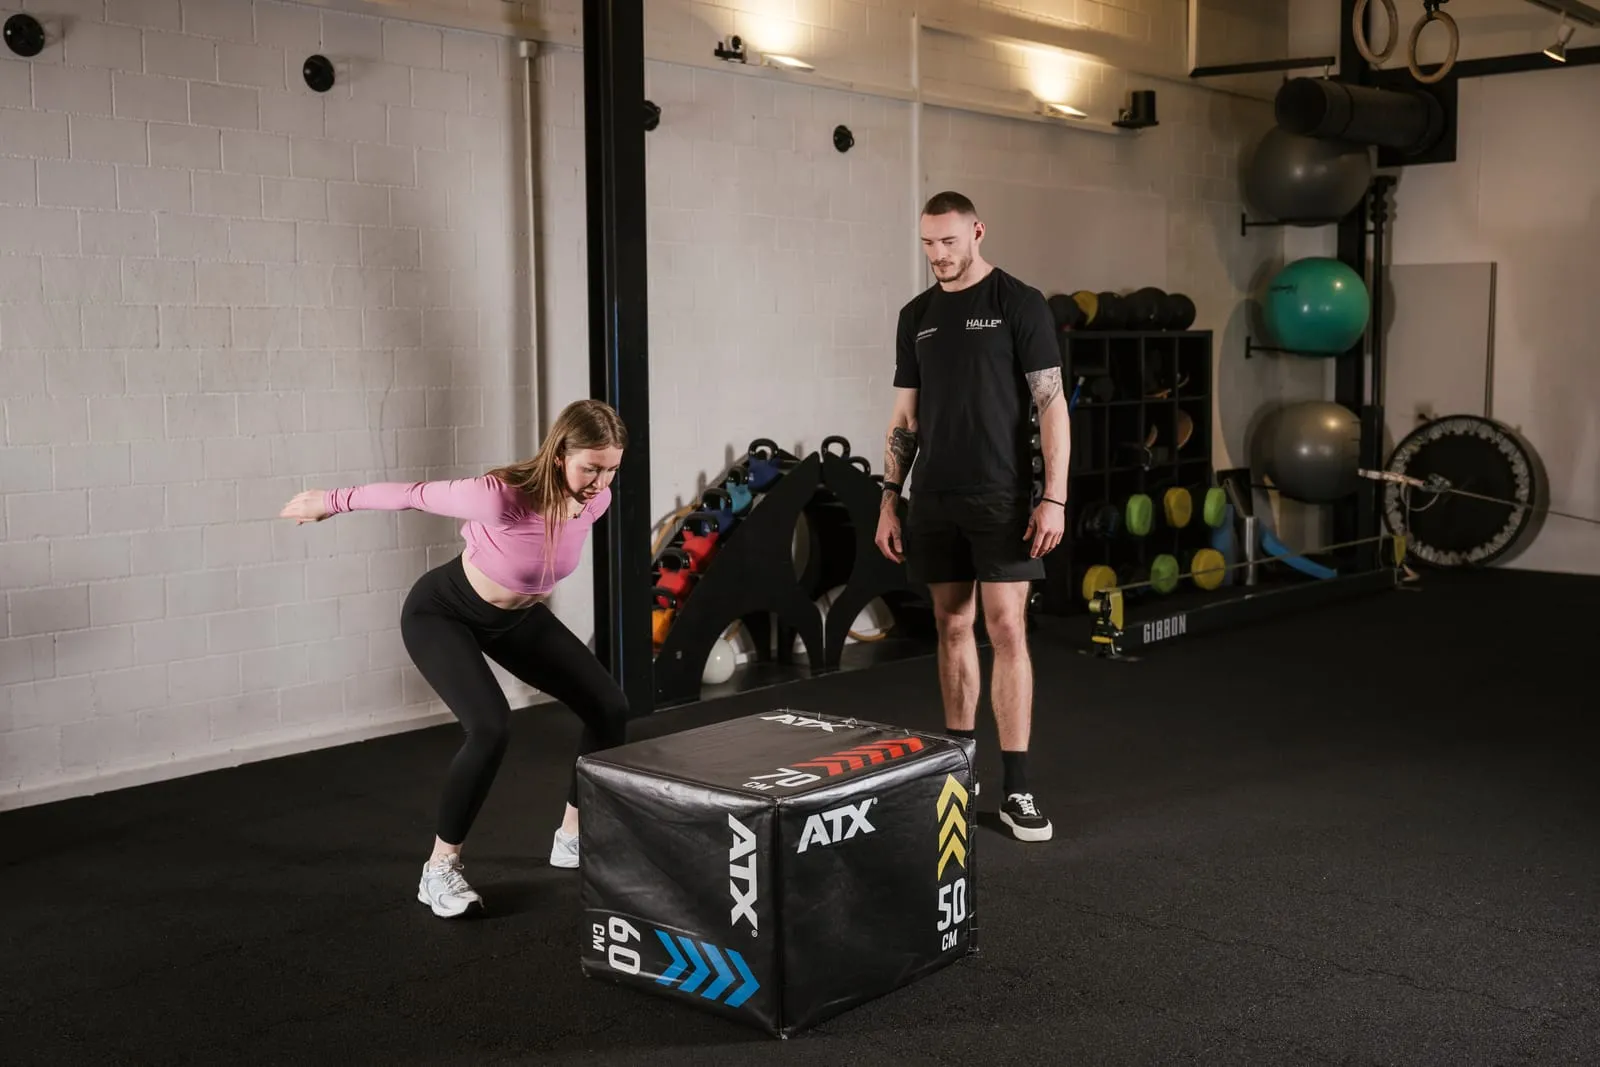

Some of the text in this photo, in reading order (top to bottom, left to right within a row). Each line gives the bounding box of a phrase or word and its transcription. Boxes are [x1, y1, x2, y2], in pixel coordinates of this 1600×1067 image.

[1143, 614, 1187, 644] GIBBON
[742, 781, 775, 791] CM
[749, 767, 821, 787] 70
[937, 877, 966, 931] 50
[592, 923, 605, 952] CM
[608, 916, 641, 975] 60
[942, 928, 958, 951] CM
